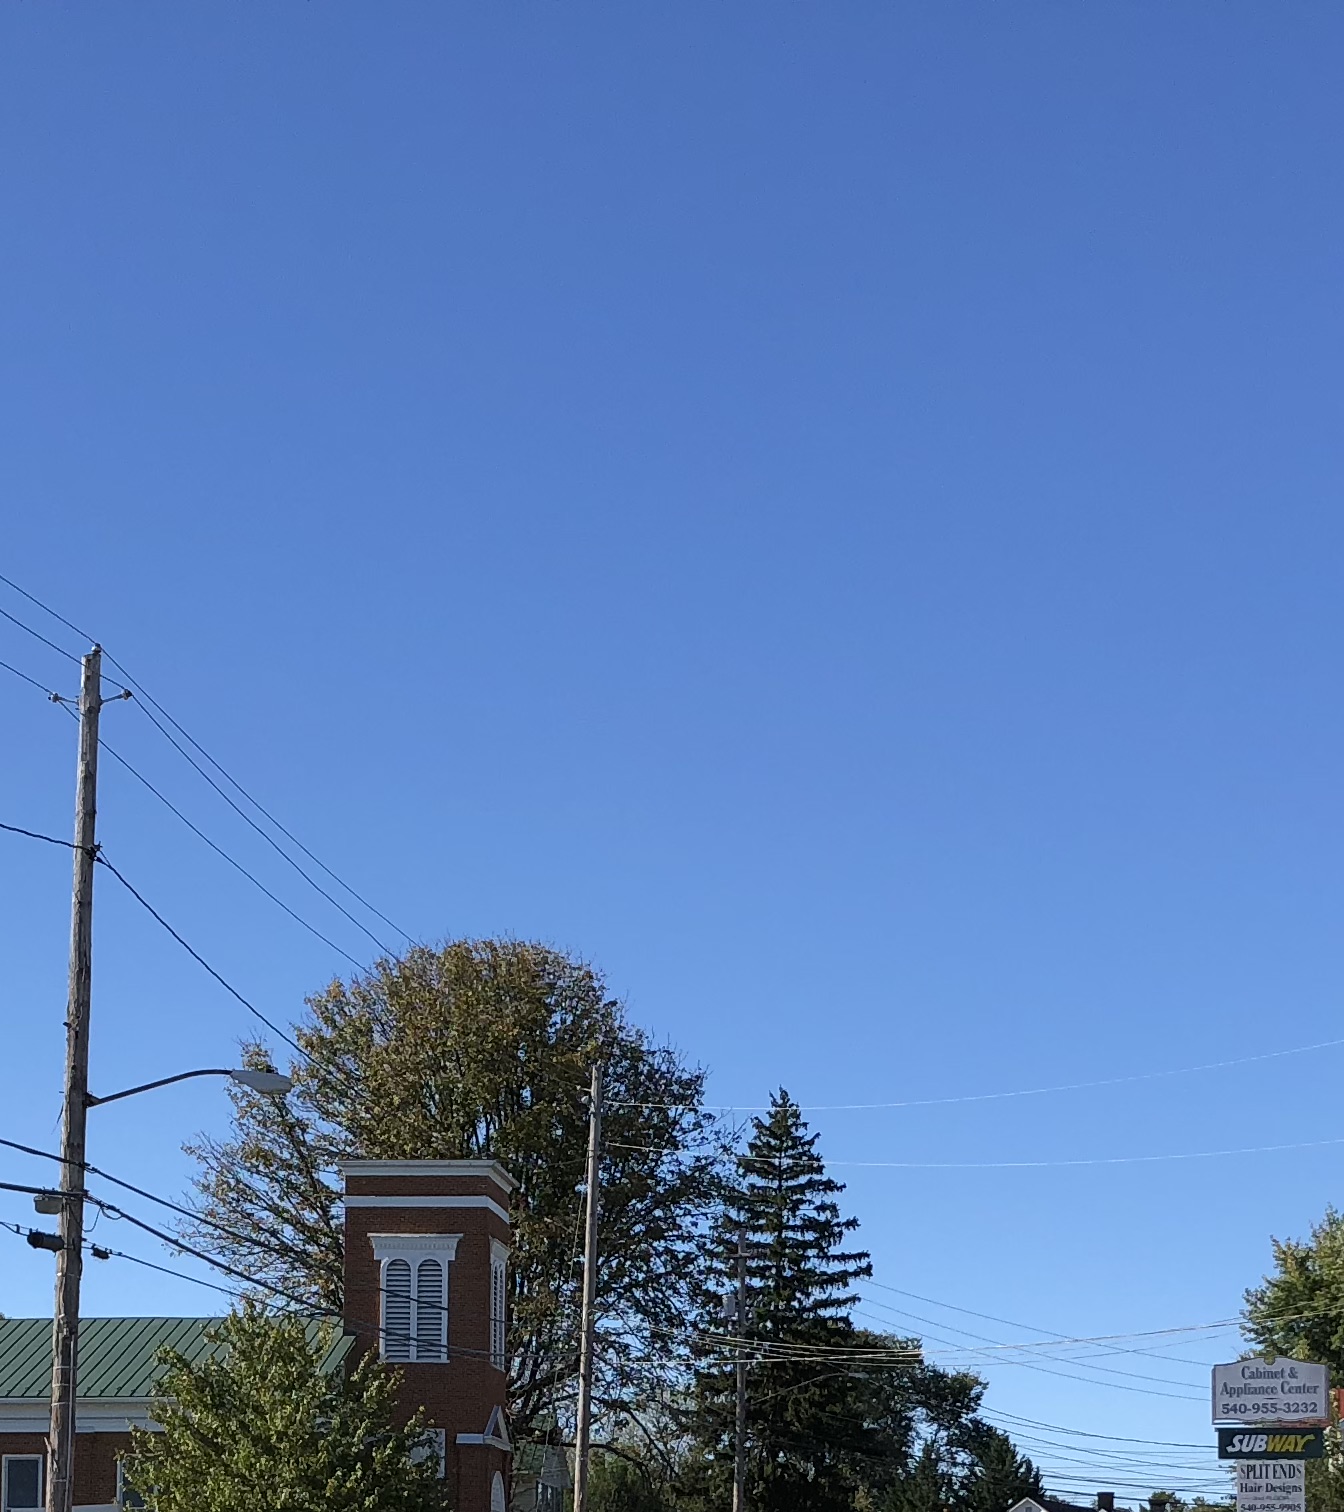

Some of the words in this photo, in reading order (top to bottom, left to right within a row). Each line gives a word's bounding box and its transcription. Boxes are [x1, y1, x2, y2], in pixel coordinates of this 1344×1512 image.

[1241, 1366, 1285, 1380] Cabinet
[1288, 1367, 1298, 1379] &
[1220, 1382, 1277, 1398] Appliance
[1281, 1381, 1319, 1395] Center
[1222, 1402, 1317, 1414] 540-955-3232
[1226, 1434, 1315, 1453] SUBWAY
[1240, 1464, 1270, 1480] SPLIT
[1272, 1464, 1303, 1480] ENDS
[1240, 1482, 1262, 1493] Hair
[1265, 1482, 1302, 1495] Designs
